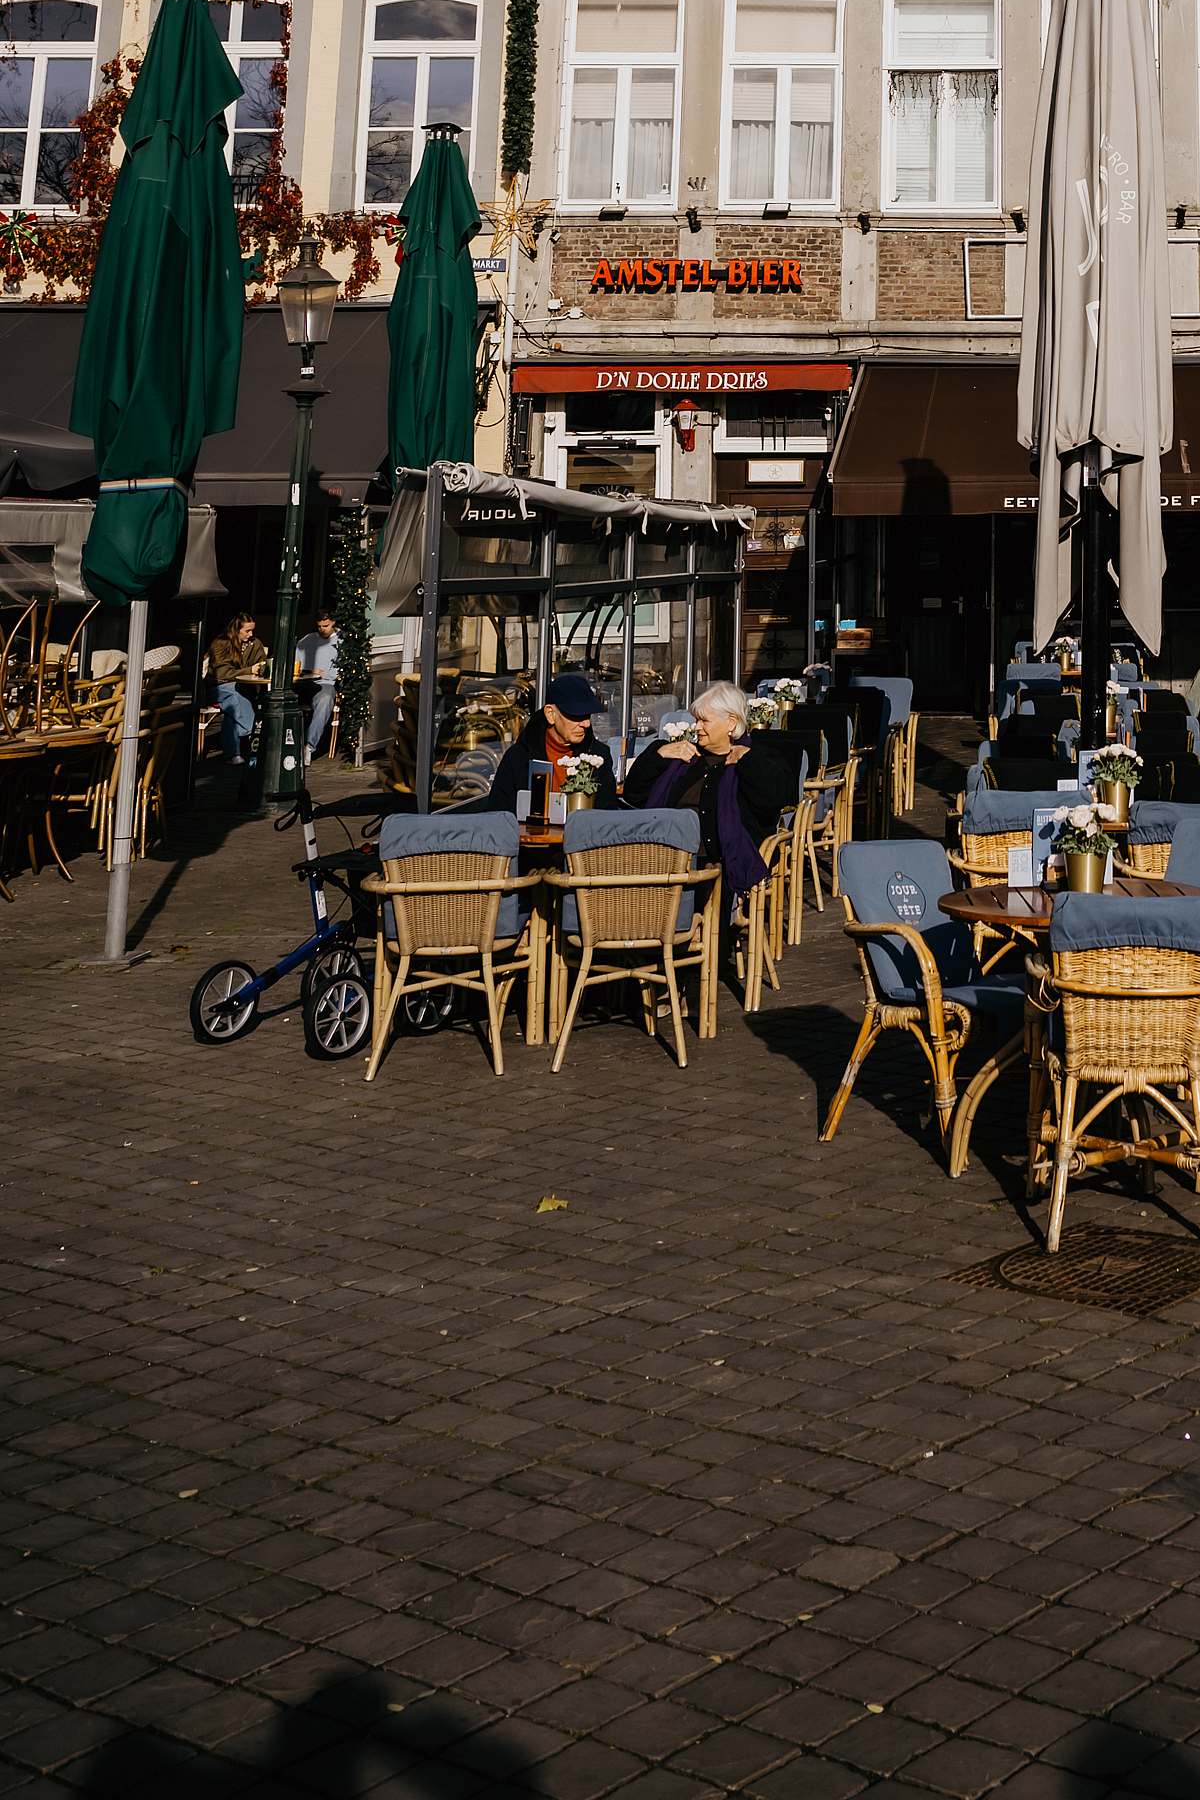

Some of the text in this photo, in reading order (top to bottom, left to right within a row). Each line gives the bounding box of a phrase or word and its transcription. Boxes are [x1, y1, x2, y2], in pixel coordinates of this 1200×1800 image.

[1115, 190, 1136, 224] BAR
[473, 259, 501, 270] MARKT
[591, 258, 804, 288] AMSTEL BIER
[636, 371, 701, 390] DOLLE
[706, 371, 769, 390] DRIES
[890, 885, 918, 896] JOUR
[896, 903, 922, 916] FÊTE
